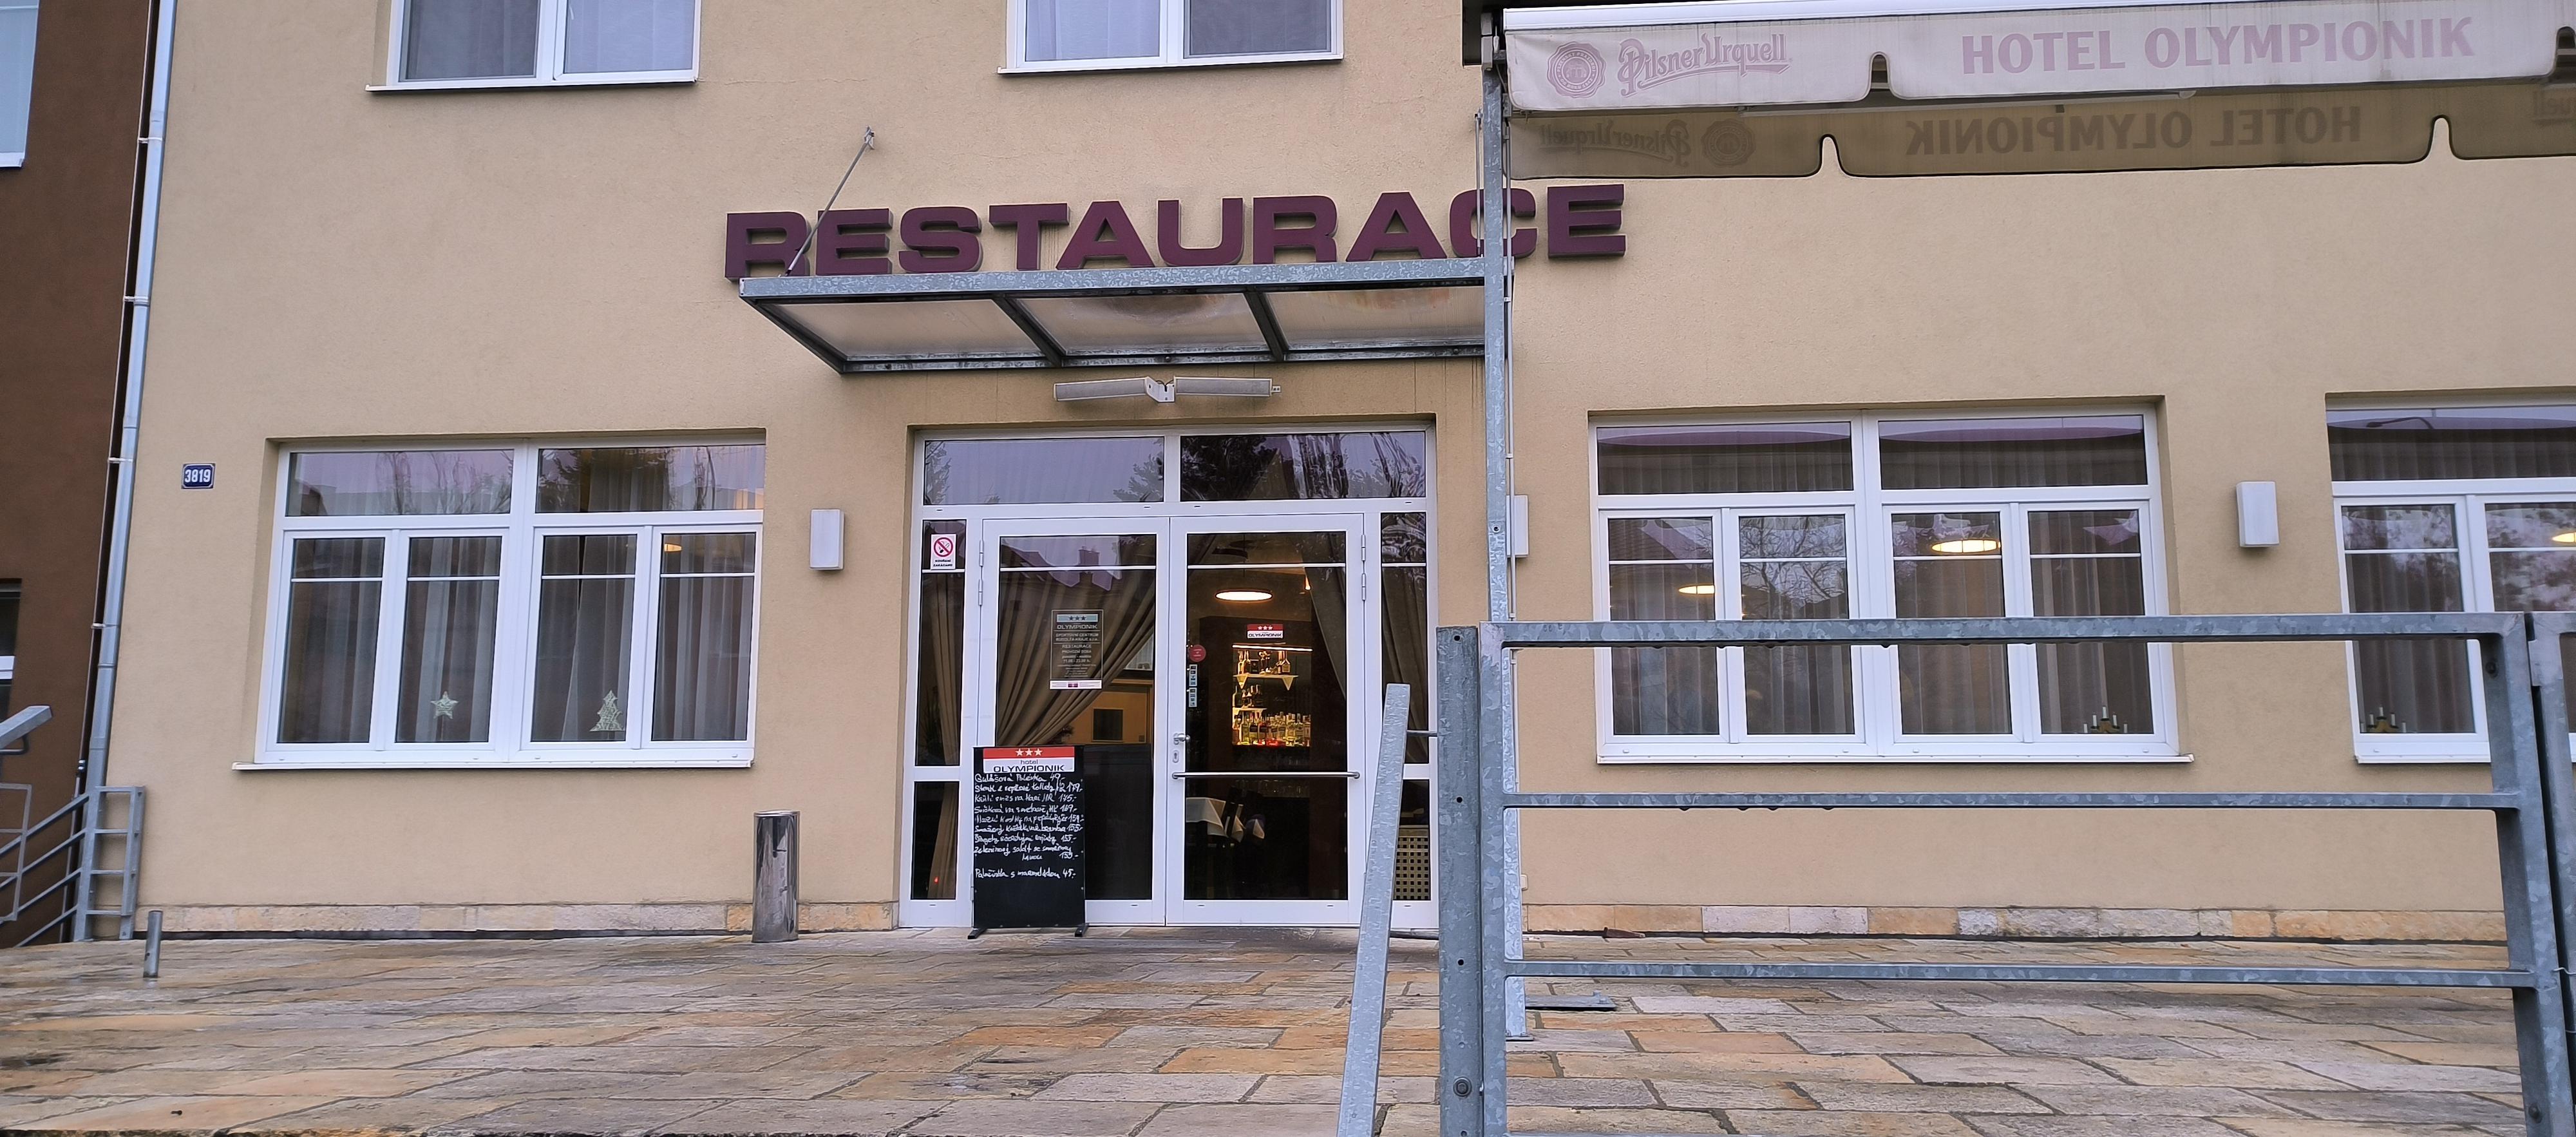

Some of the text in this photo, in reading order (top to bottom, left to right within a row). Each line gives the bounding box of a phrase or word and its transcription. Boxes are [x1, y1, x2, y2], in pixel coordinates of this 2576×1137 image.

[1617, 33, 1788, 97] Pilsner Urquell
[1962, 16, 2476, 75] HOTEL OLYMPIONIK
[724, 183, 1627, 282] RESTAURACE
[184, 469, 211, 483] 3819
[994, 765, 1065, 773] OLYMPIONIK
